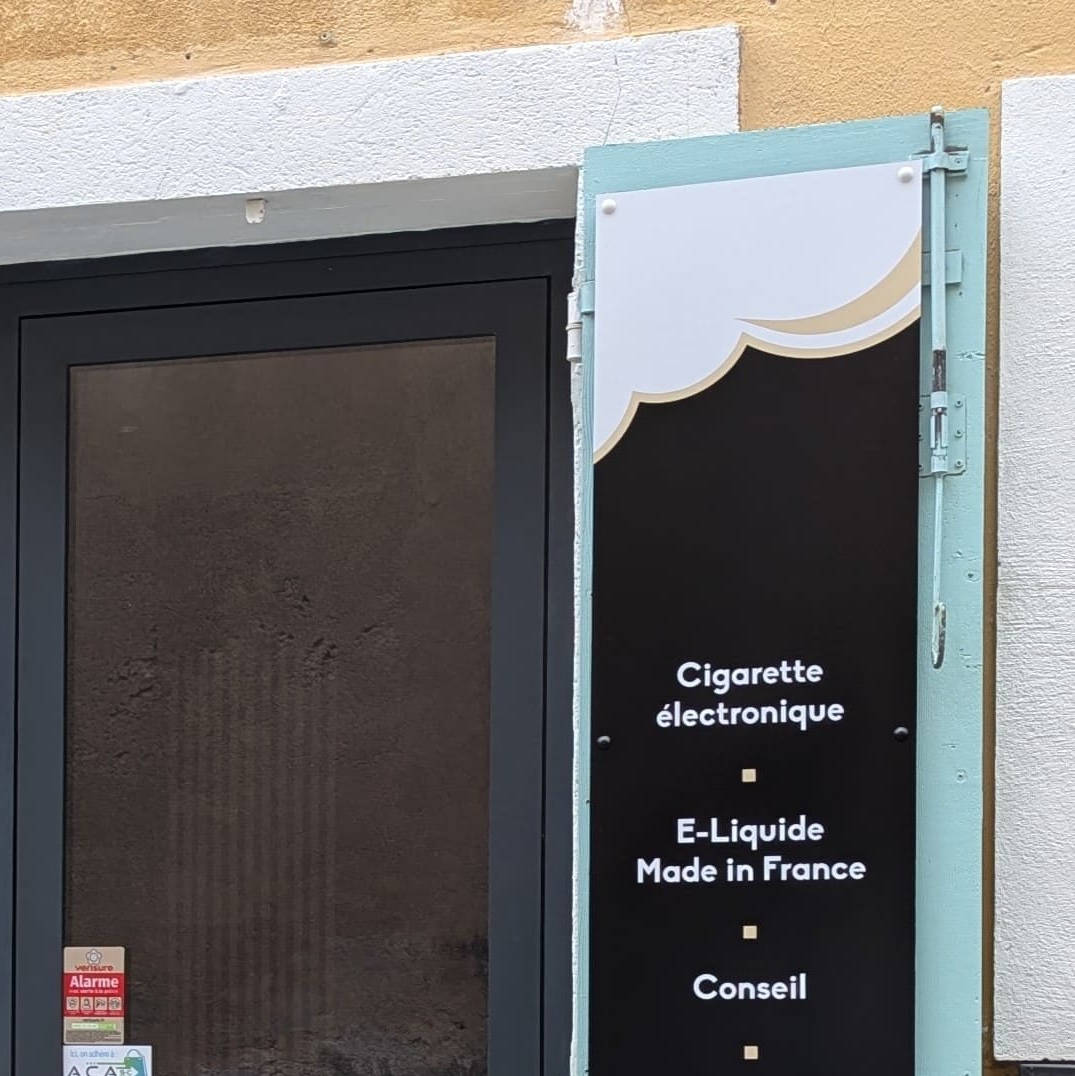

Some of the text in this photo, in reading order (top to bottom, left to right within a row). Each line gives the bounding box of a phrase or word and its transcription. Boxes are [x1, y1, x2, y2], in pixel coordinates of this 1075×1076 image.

[676, 659, 824, 695] Cigarette
[656, 698, 845, 731] électronique
[677, 814, 825, 851] E-Liquide
[637, 855, 867, 884] Made in France
[70, 974, 119, 988] Alarme
[693, 972, 807, 1000] Conseil
